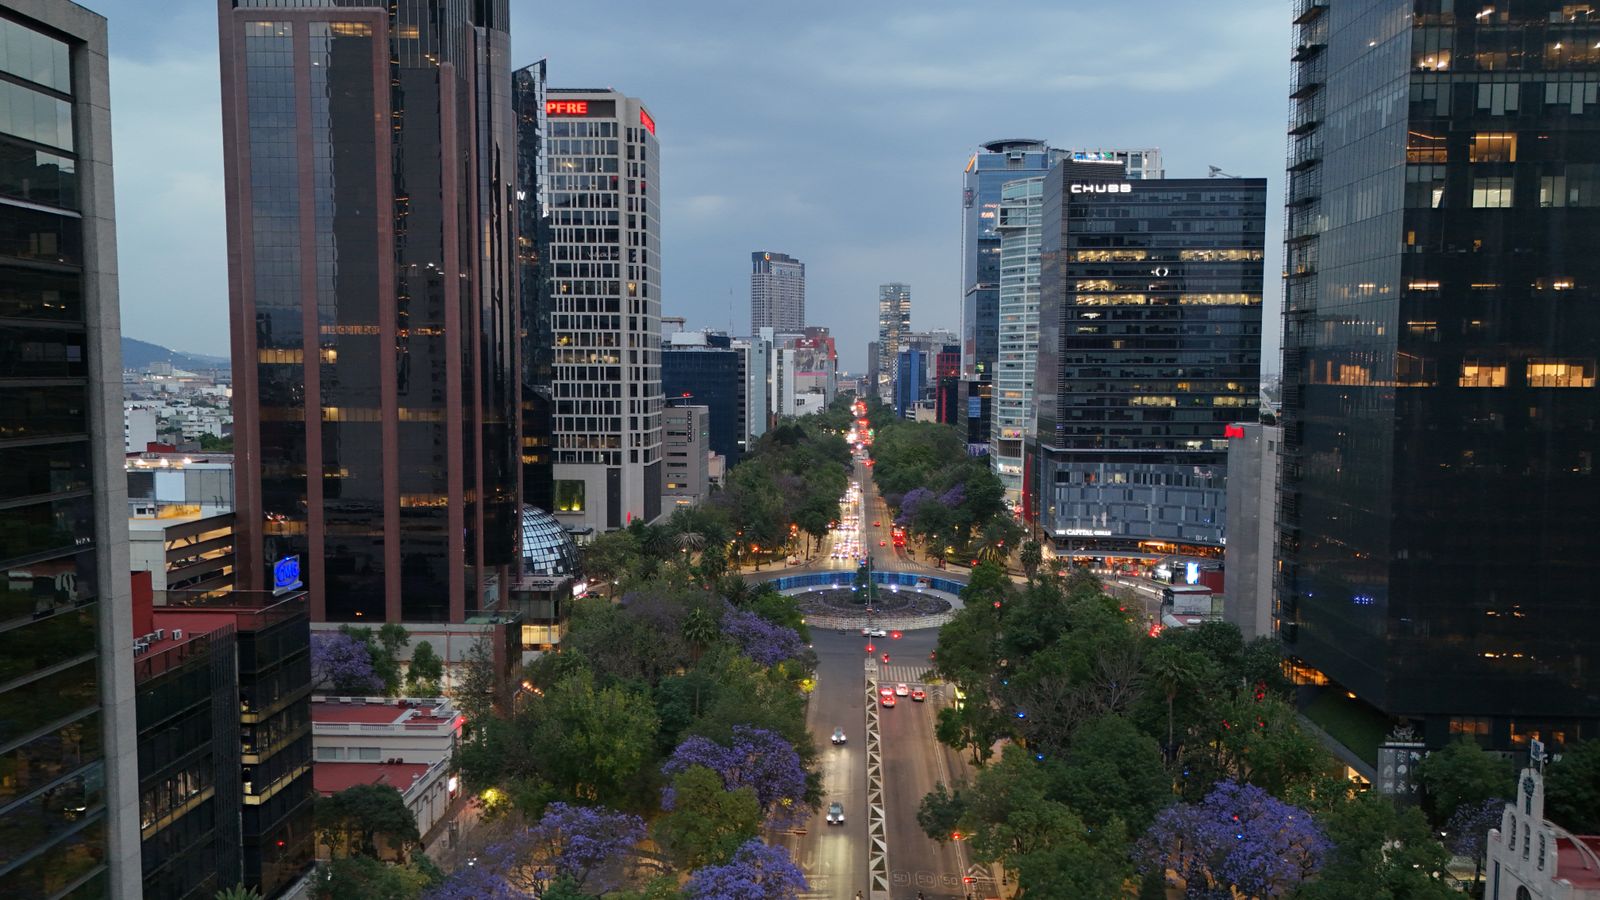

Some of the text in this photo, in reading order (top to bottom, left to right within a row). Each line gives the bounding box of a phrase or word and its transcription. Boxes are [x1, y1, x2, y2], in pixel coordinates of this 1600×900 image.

[547, 102, 587, 113] PFRE
[1071, 184, 1131, 193] CHUBB
[1066, 528, 1094, 536] CAPITAL
